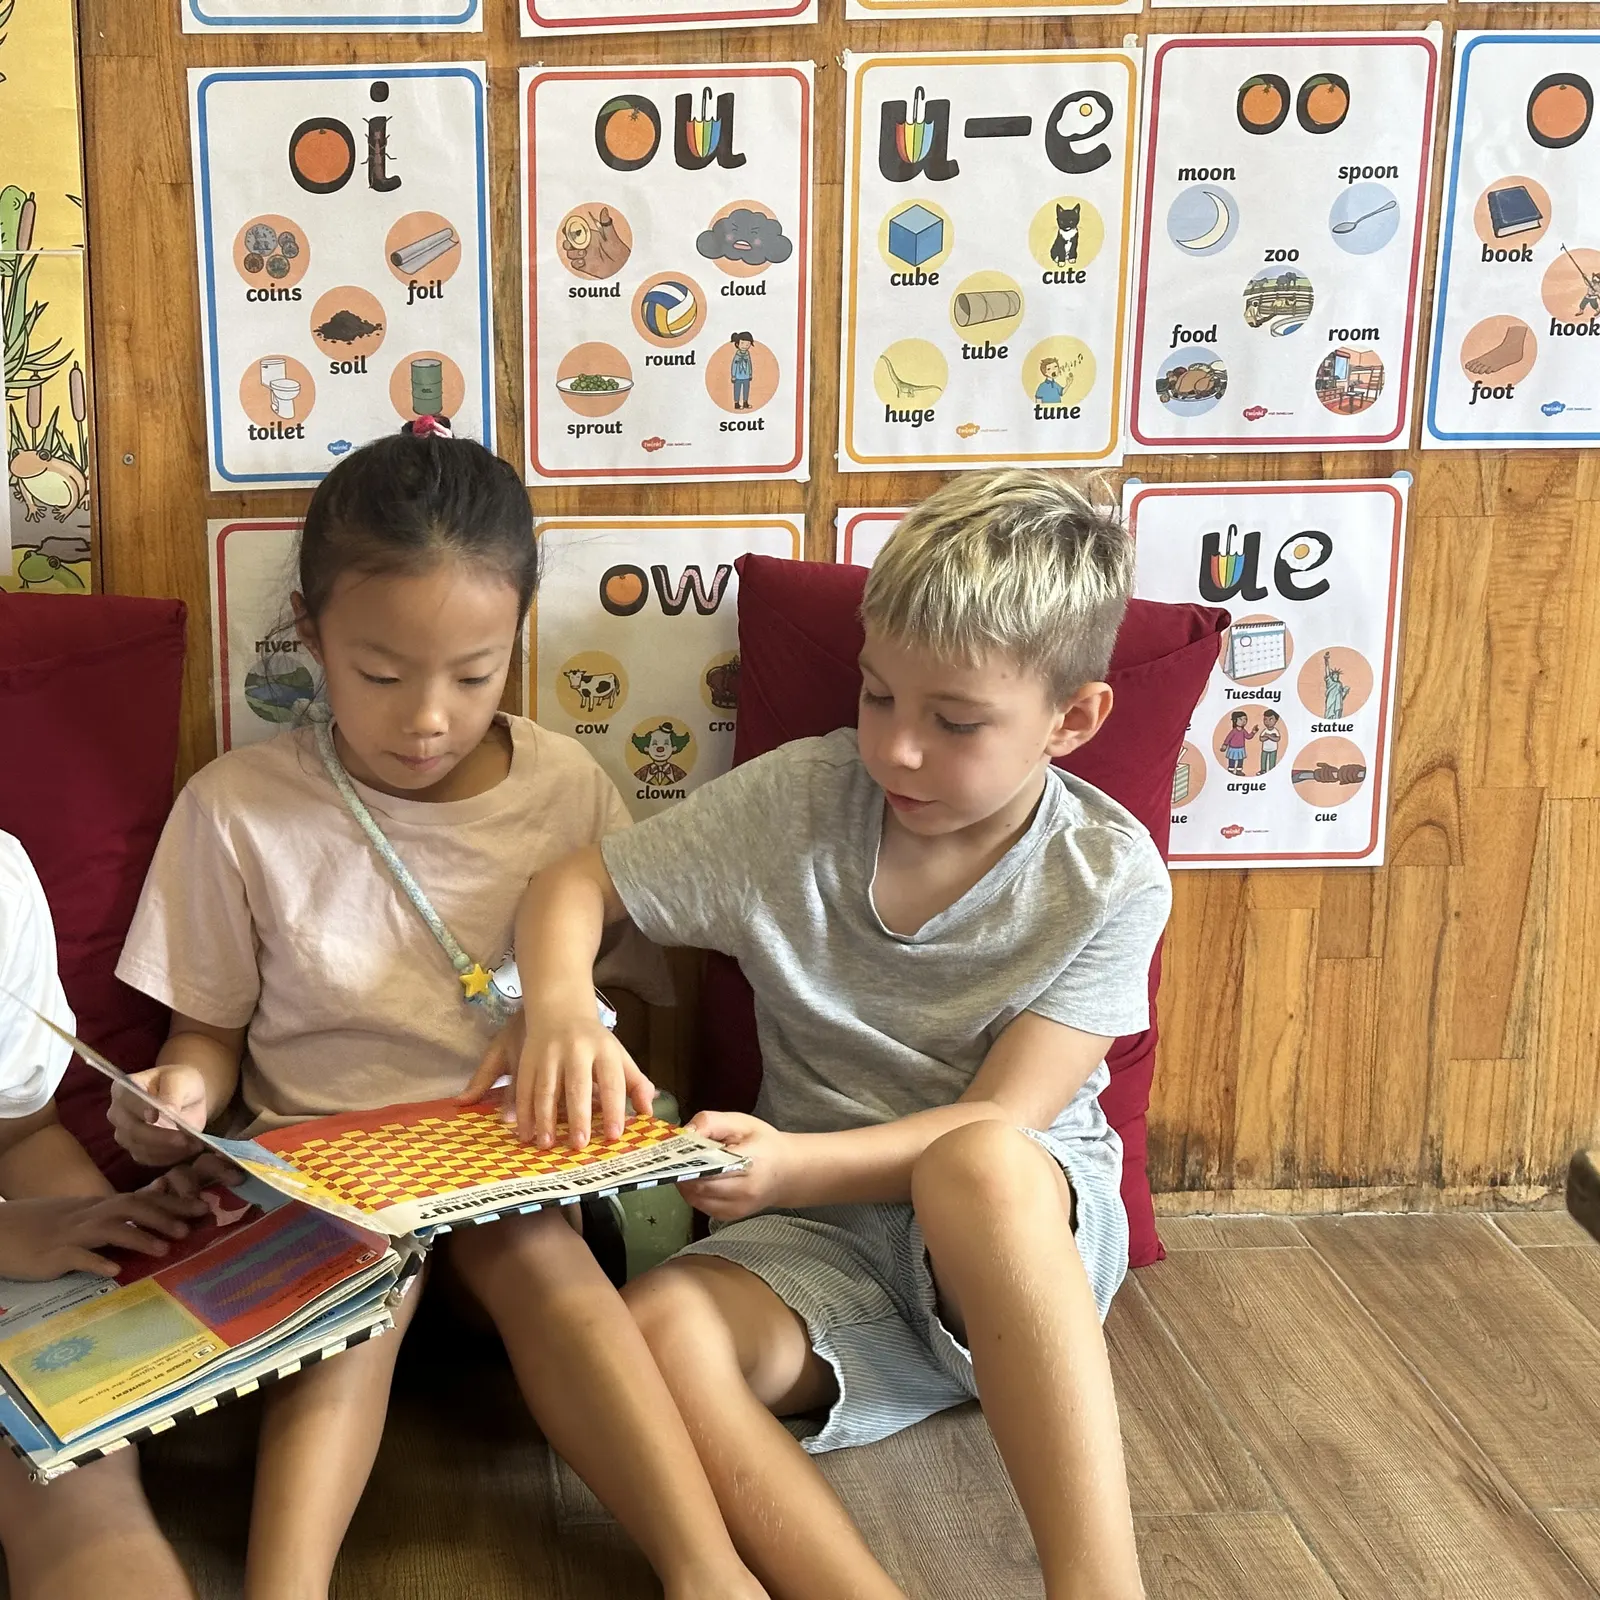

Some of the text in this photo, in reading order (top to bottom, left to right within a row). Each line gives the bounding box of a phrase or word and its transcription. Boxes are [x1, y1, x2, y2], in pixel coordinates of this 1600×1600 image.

[289, 81, 402, 194] oi
[595, 87, 747, 172] ou
[1177, 167, 1236, 181] moon
[1337, 165, 1399, 185] spoon
[1264, 249, 1300, 262] zoo
[1481, 243, 1533, 263] book
[891, 267, 939, 286] cube
[1043, 266, 1086, 284] cute
[247, 282, 301, 302] coins
[407, 280, 443, 305] foil
[568, 281, 621, 299] sound
[720, 279, 767, 297] cloud
[1328, 327, 1380, 342] room
[1550, 318, 1600, 336] hook
[1170, 325, 1217, 348] food
[645, 350, 696, 367] round
[962, 340, 1008, 359] tube
[330, 354, 367, 374] soil
[1469, 381, 1514, 405] foot
[885, 404, 935, 426] huge
[1034, 404, 1080, 420] tune
[248, 420, 304, 440] toilet
[567, 420, 623, 438] sprout
[719, 417, 765, 432] scout
[1199, 524, 1333, 602] ue
[599, 564, 732, 616] ow
[255, 636, 302, 653] river
[1224, 687, 1282, 703] Tuesday
[575, 723, 610, 735] cow
[708, 721, 735, 732] cro
[1310, 722, 1354, 733] statue
[636, 783, 687, 800] clown
[1226, 782, 1267, 795] argue
[1314, 813, 1338, 822] cue
